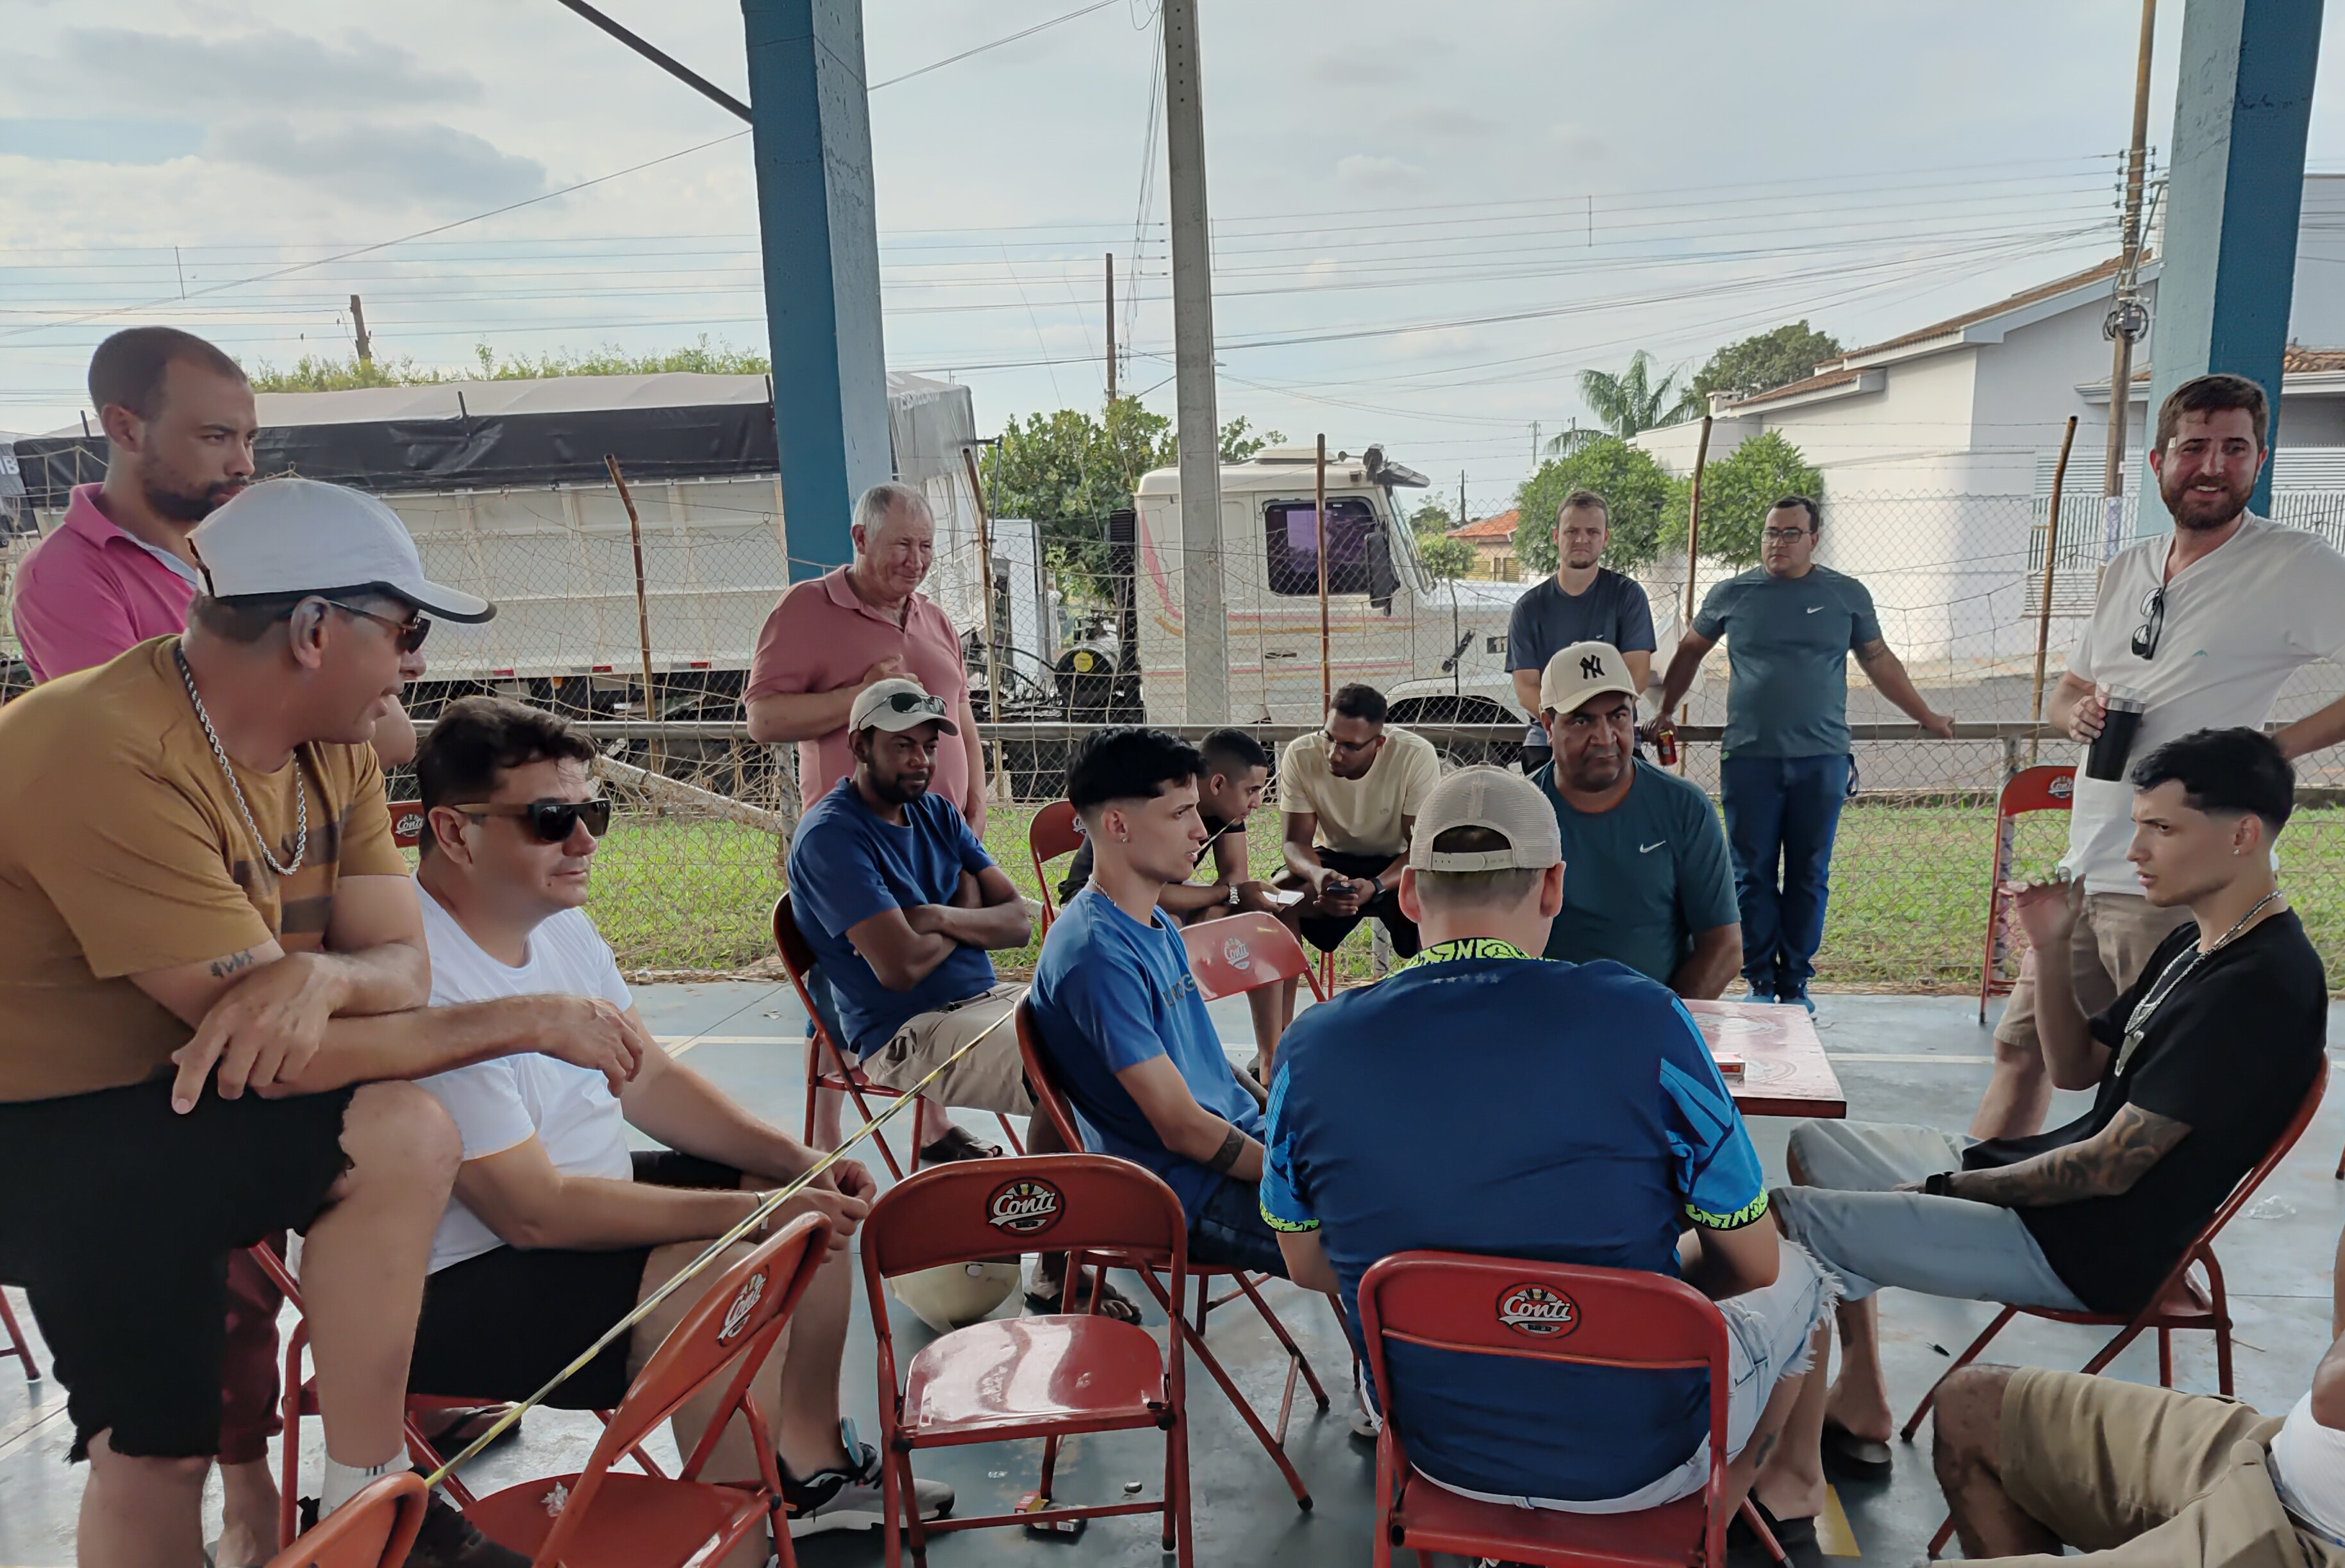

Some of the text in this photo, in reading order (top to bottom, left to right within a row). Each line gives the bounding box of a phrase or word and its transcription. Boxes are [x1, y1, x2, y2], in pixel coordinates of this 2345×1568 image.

[1579, 655, 1605, 680] NY
[1224, 944, 1249, 963] Conti
[990, 1191, 1057, 1222] Conti
[721, 1277, 767, 1334] Conti
[1501, 1296, 1572, 1322] Conti
